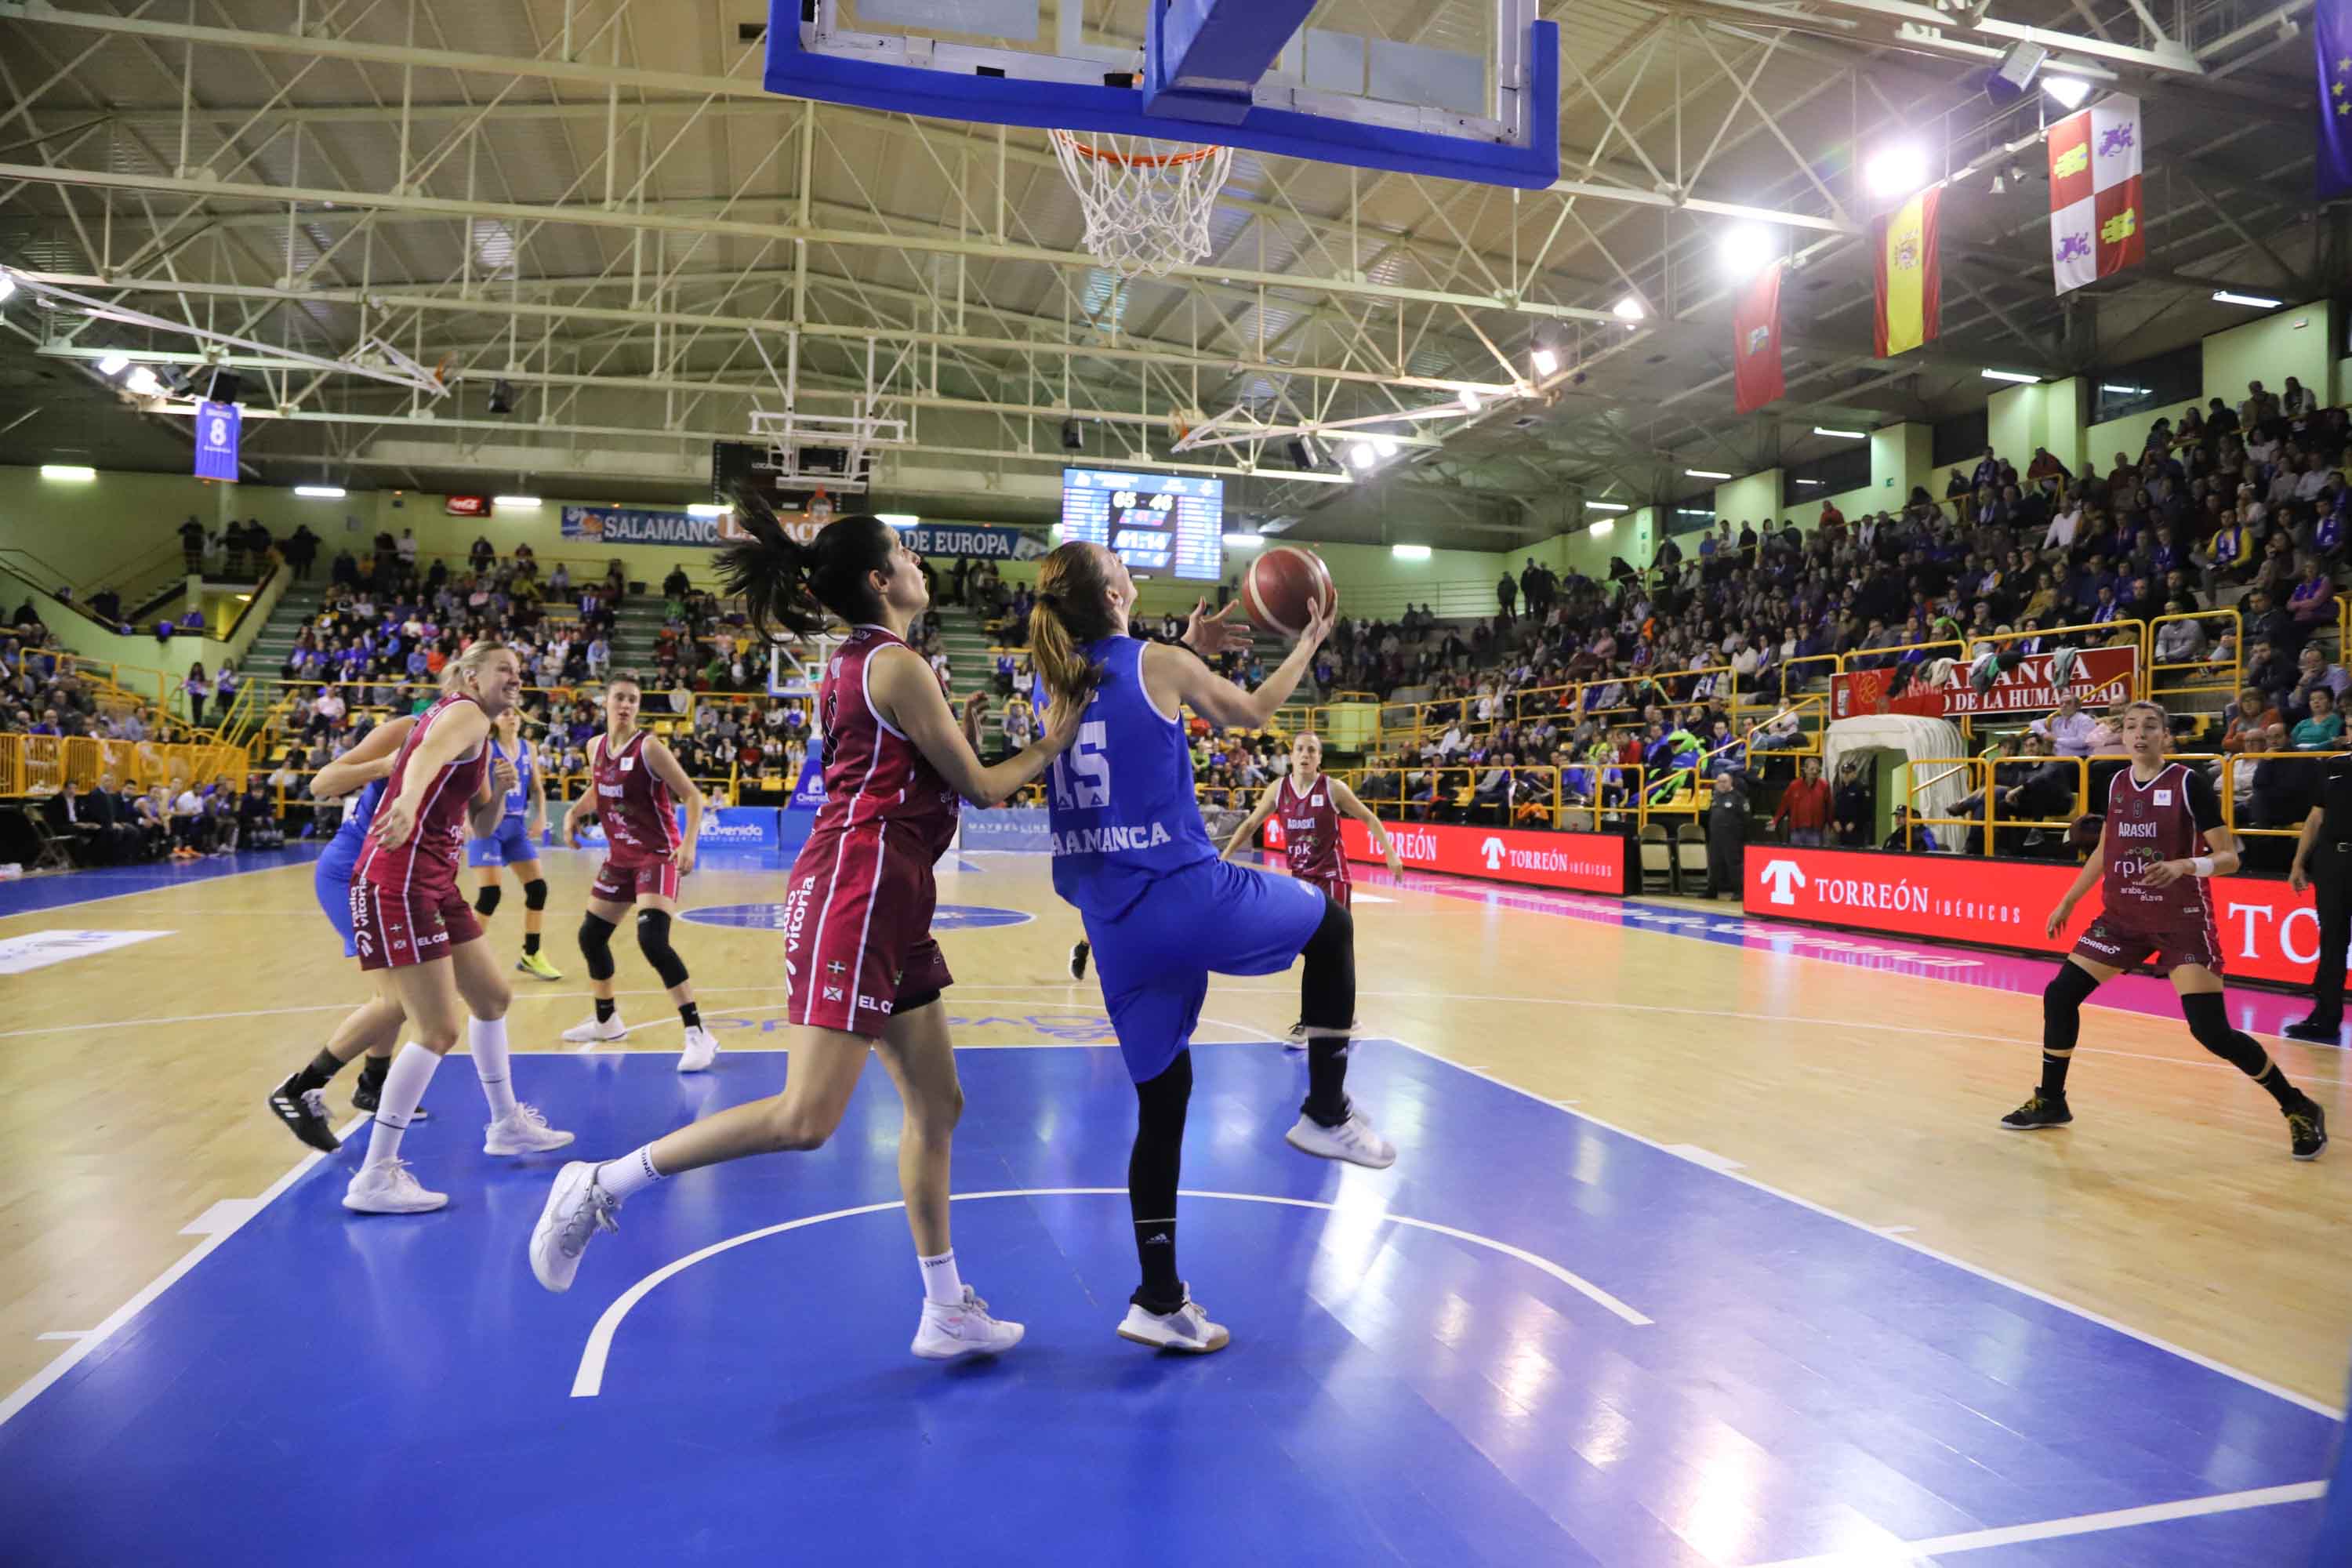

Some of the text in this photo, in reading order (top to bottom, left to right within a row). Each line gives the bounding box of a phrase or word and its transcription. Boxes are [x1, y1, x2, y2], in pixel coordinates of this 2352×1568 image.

[210, 418, 226, 445] 8
[1113, 491, 1137, 508] 65
[1149, 493, 1174, 511] 46
[604, 515, 722, 543] SALAMANC
[905, 530, 1010, 555] DE EUROPA
[1956, 695, 1977, 711] DE
[1984, 691, 2002, 710] LA
[1288, 843, 1312, 857] rpk
[1509, 848, 1568, 872] TORREÓN
[1815, 879, 2020, 924] TORREÓN IBÉRICOS
[781, 876, 815, 953] vitoria
[858, 994, 879, 1011] EL
